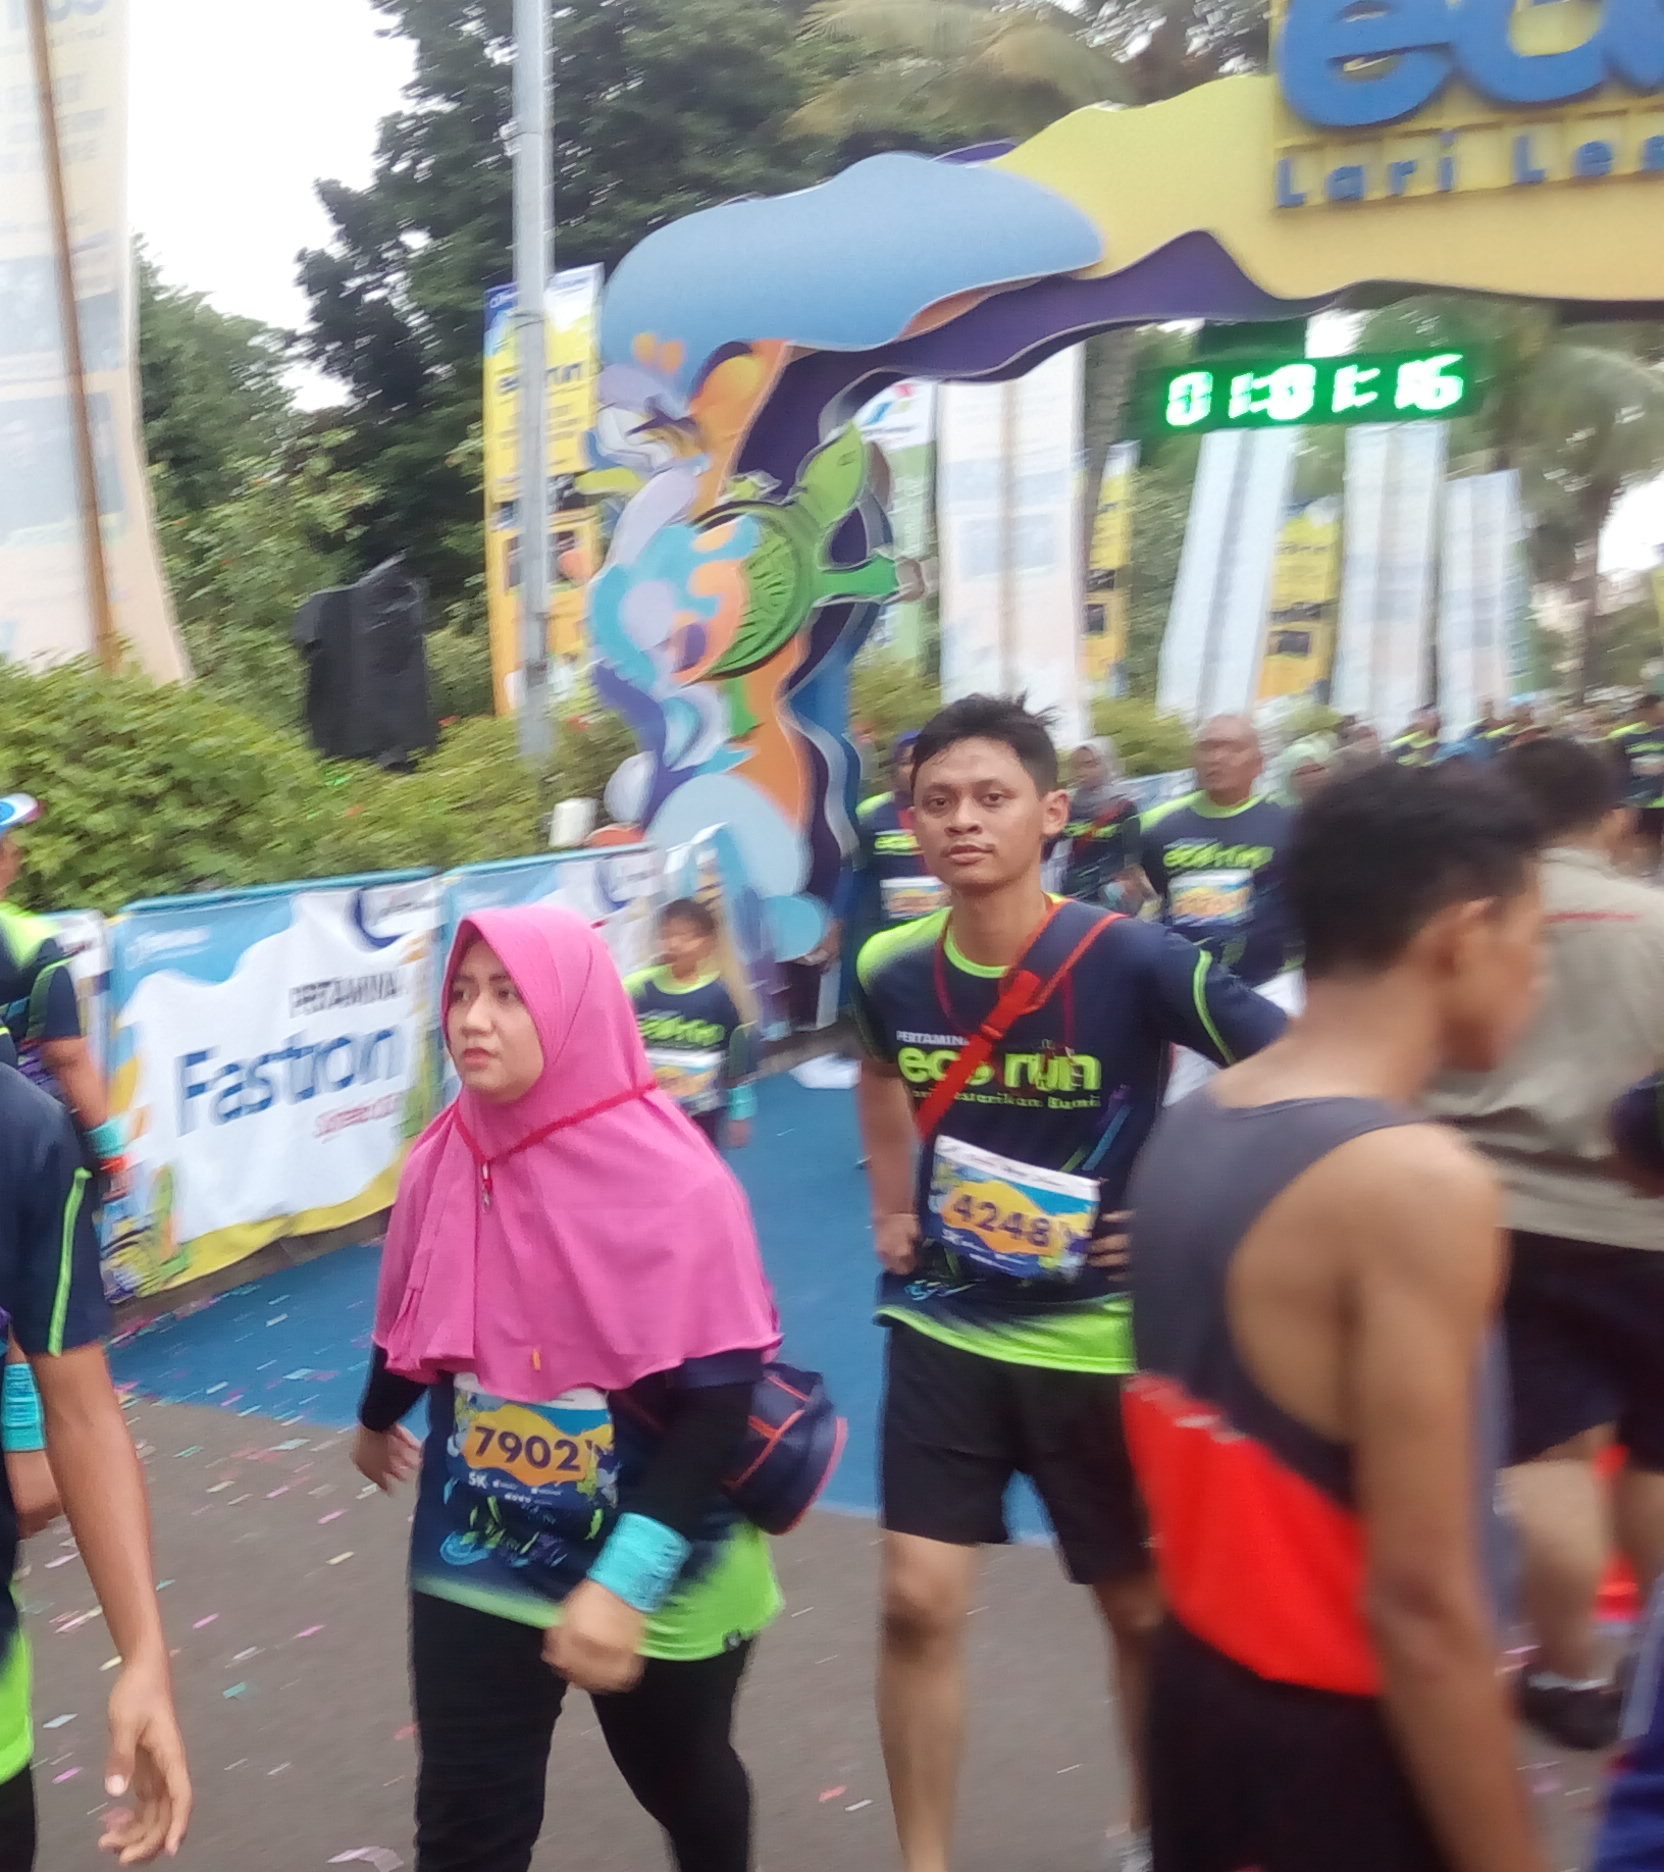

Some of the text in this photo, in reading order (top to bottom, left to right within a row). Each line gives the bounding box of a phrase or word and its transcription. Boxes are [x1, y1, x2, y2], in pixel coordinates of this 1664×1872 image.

[1279, 0, 1664, 128] ec
[1276, 129, 1457, 208] Lari
[174, 1018, 410, 1138] Fastron
[1004, 1052, 1102, 1092] run
[953, 1194, 1050, 1247] 4248
[474, 1425, 582, 1472] 7902
[468, 1471, 489, 1489] 5K
